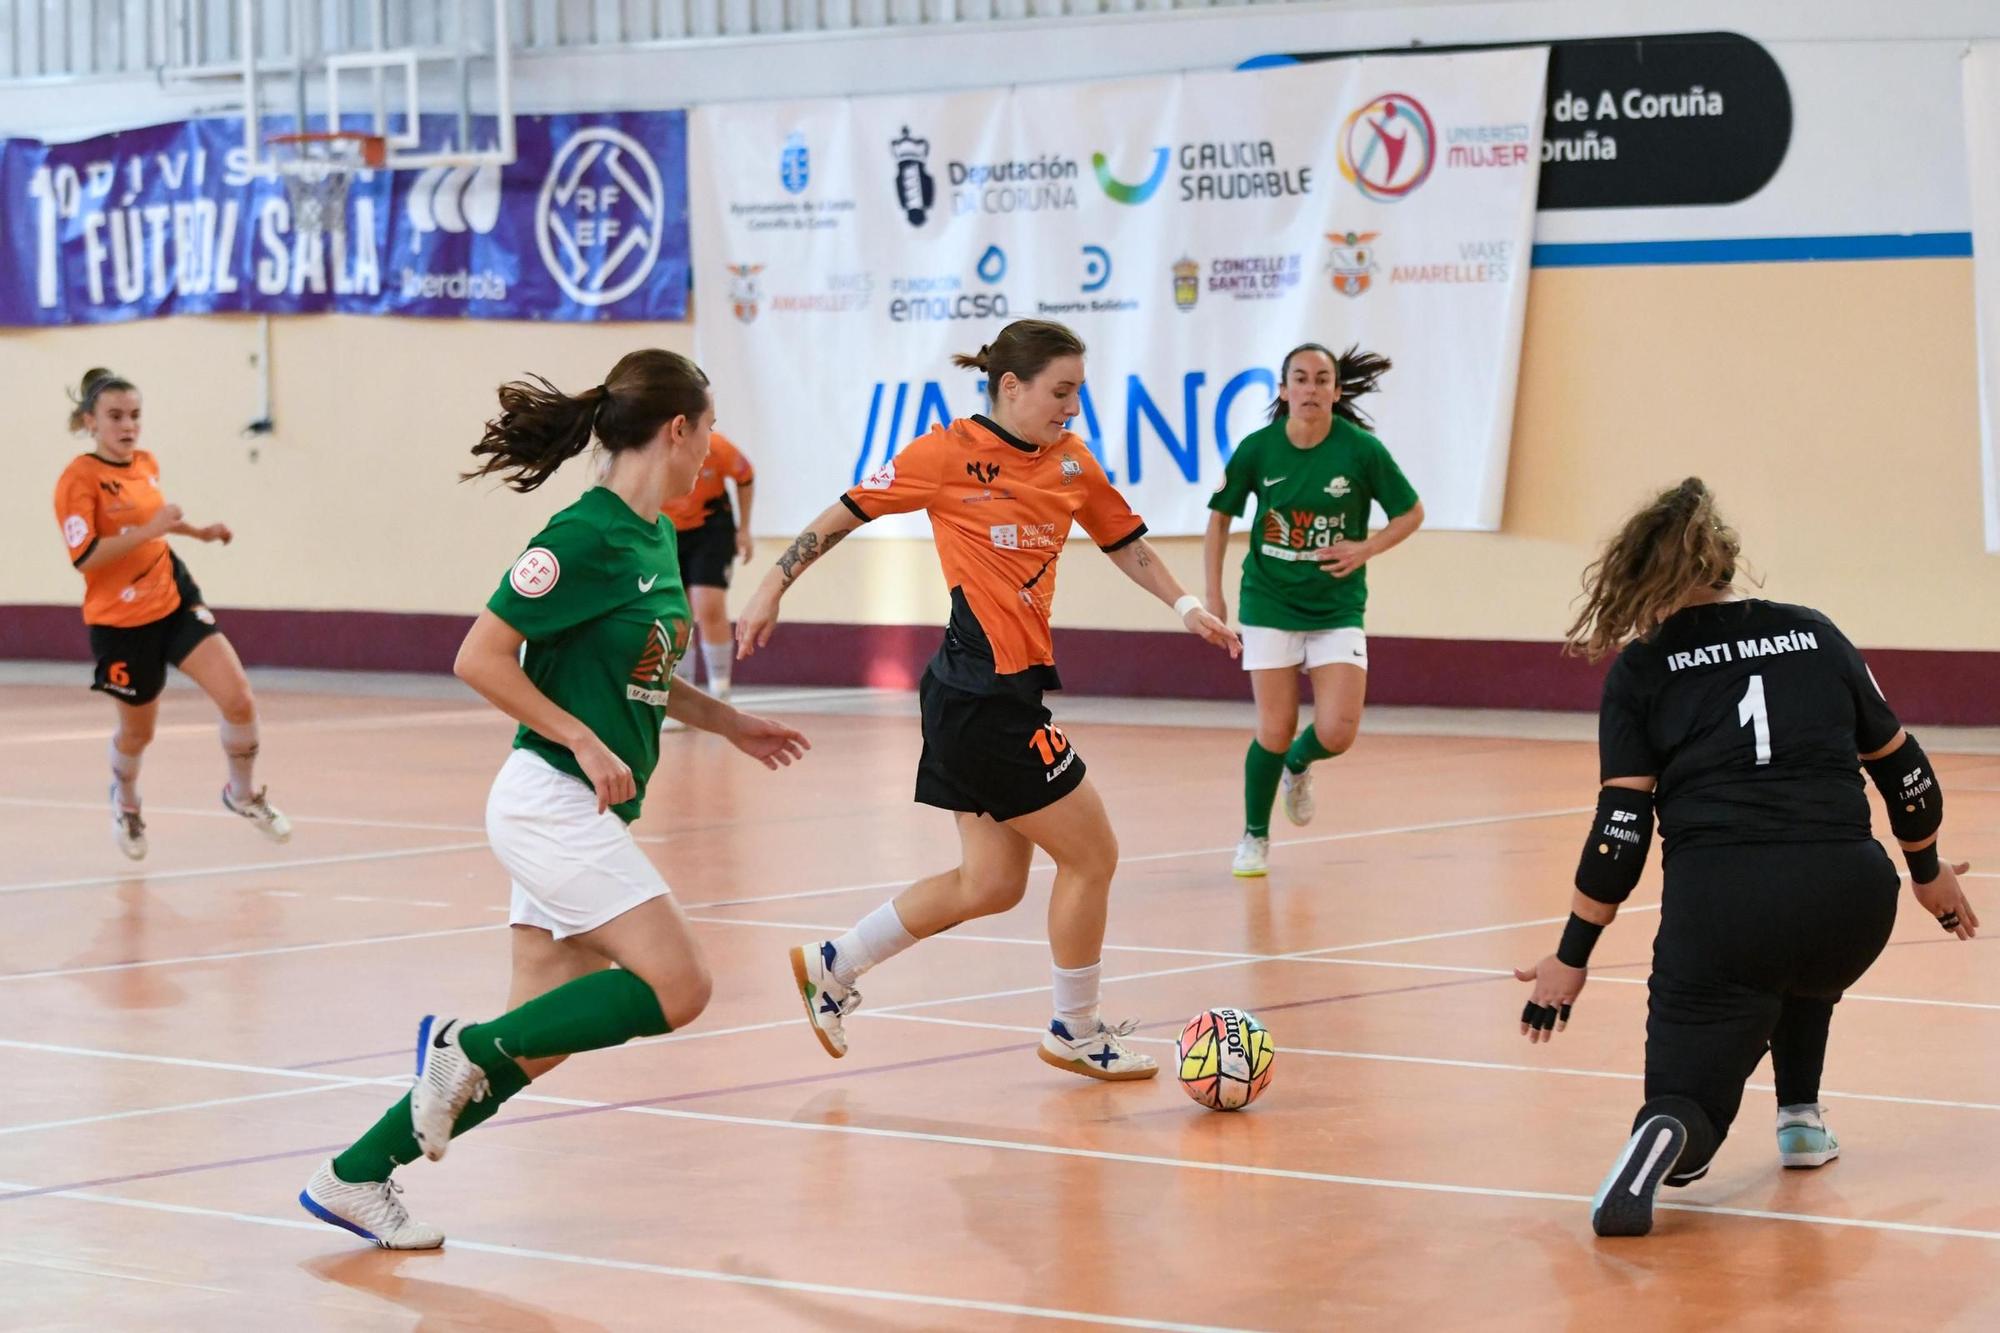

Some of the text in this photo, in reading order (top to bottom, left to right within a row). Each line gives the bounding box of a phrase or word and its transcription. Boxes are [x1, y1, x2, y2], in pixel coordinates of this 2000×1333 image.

[1554, 85, 1724, 122] de A Coruña
[1179, 140, 1276, 170] GALICIA
[1447, 144, 1529, 168] MUJER
[948, 156, 1078, 186] Deputación
[1179, 167, 1312, 201] SAUDABLE
[85, 190, 380, 305] FÚTBOL SALA
[1291, 508, 1346, 530] West
[1290, 527, 1345, 549] Side
[1667, 630, 1819, 672] IRATI MARÍN
[109, 661, 131, 688] 6
[1737, 675, 1772, 766] 1
[1028, 723, 1067, 766] 10
[1902, 767, 1922, 787] SP
[1610, 809, 1638, 823] SP
[1918, 797, 1926, 809] 1
